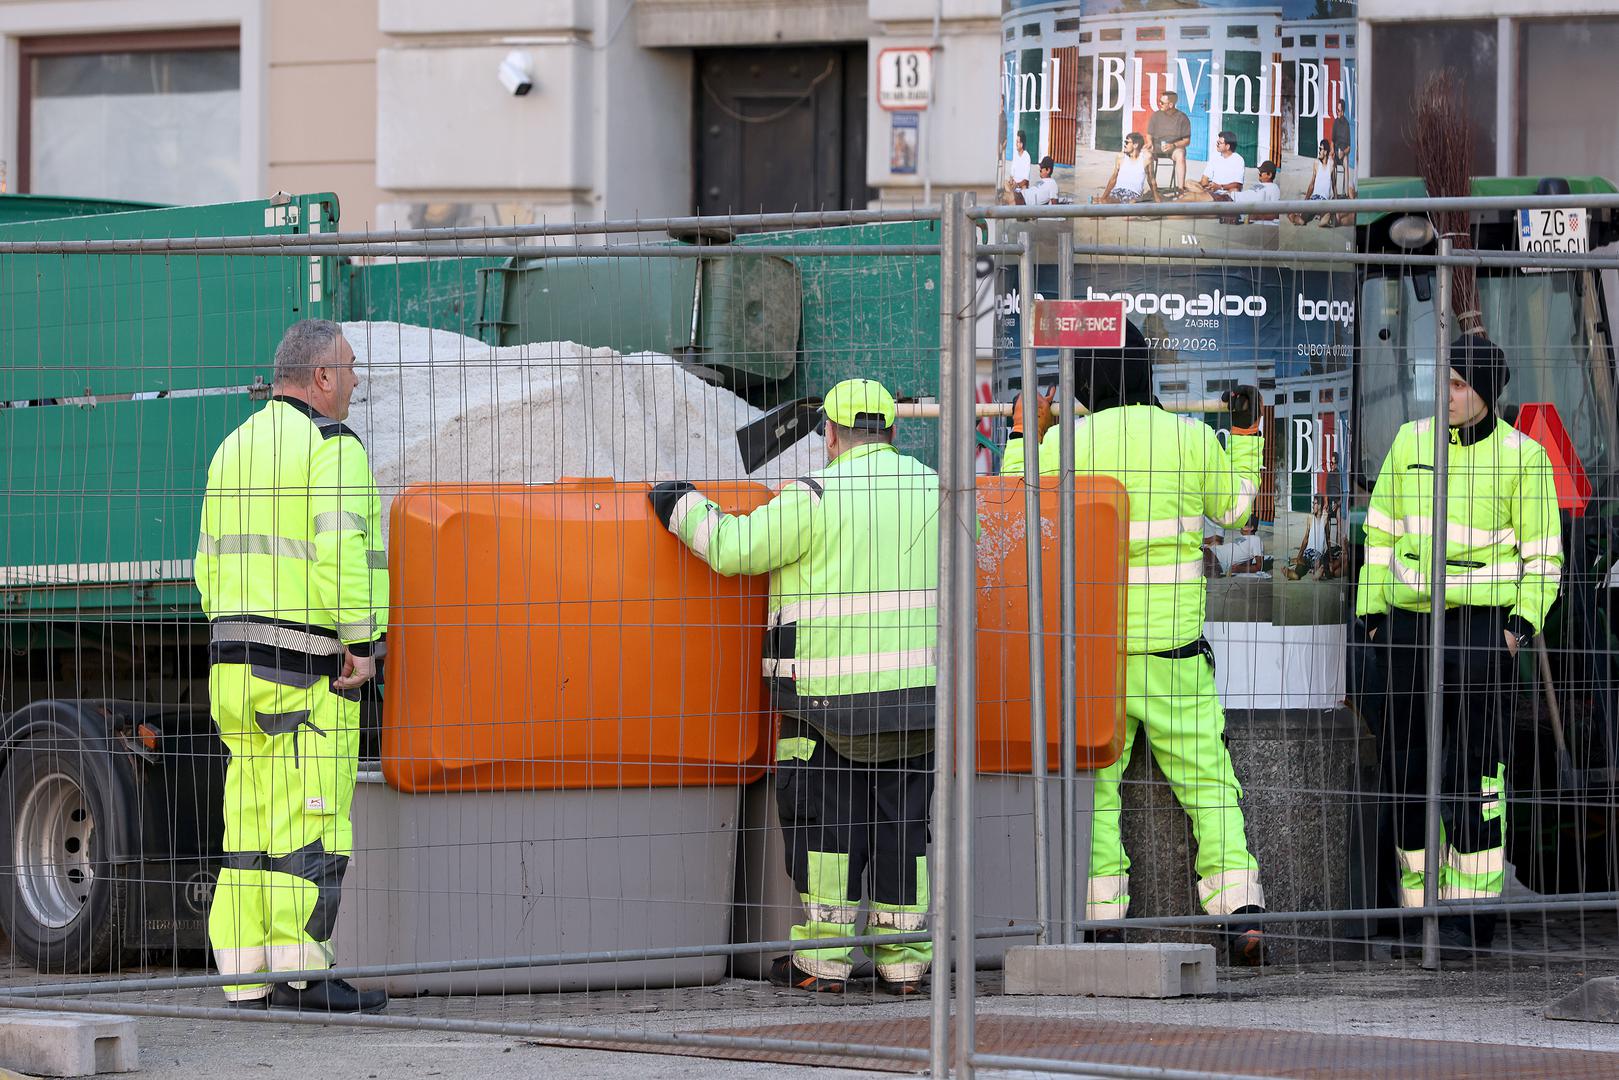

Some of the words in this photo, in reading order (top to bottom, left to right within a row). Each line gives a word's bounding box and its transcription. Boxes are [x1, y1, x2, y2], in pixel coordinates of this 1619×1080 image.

[895, 54, 919, 88] 13
[1541, 209, 1565, 237] ZG
[1185, 319, 1220, 329] ZAGREB
[1297, 343, 1331, 356] SUBOTA
